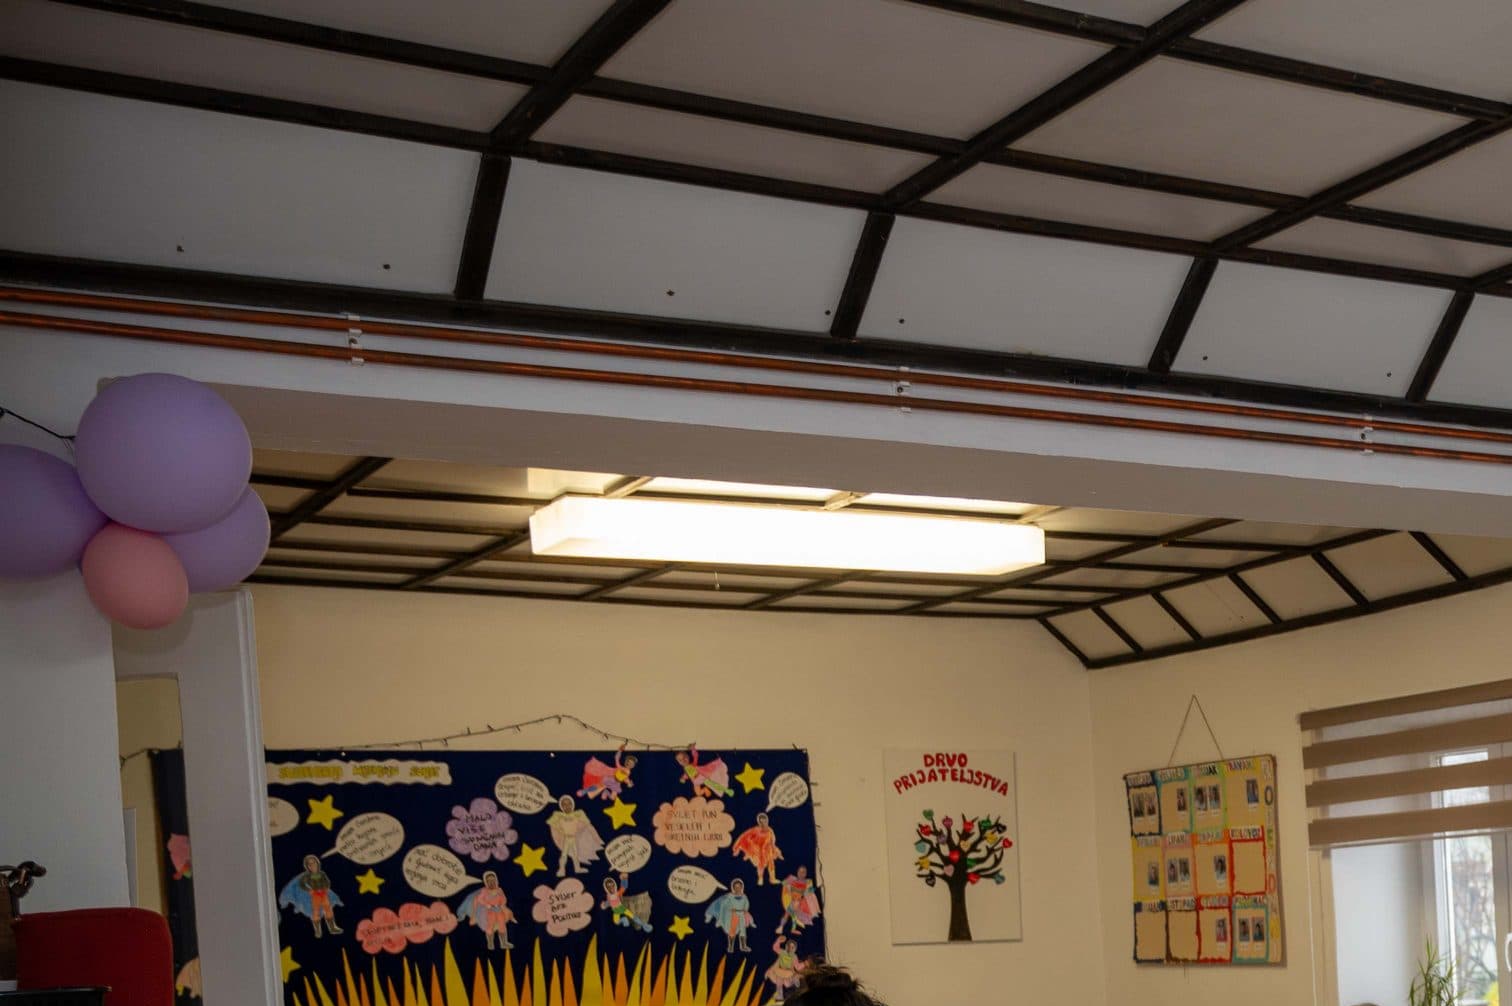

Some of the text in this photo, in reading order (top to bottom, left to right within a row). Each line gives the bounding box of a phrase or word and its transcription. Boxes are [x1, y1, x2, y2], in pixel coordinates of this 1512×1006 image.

[923, 753, 968, 768] DRVO
[893, 768, 1008, 796] PRIJATELJSTVA
[465, 813, 492, 824] MALO
